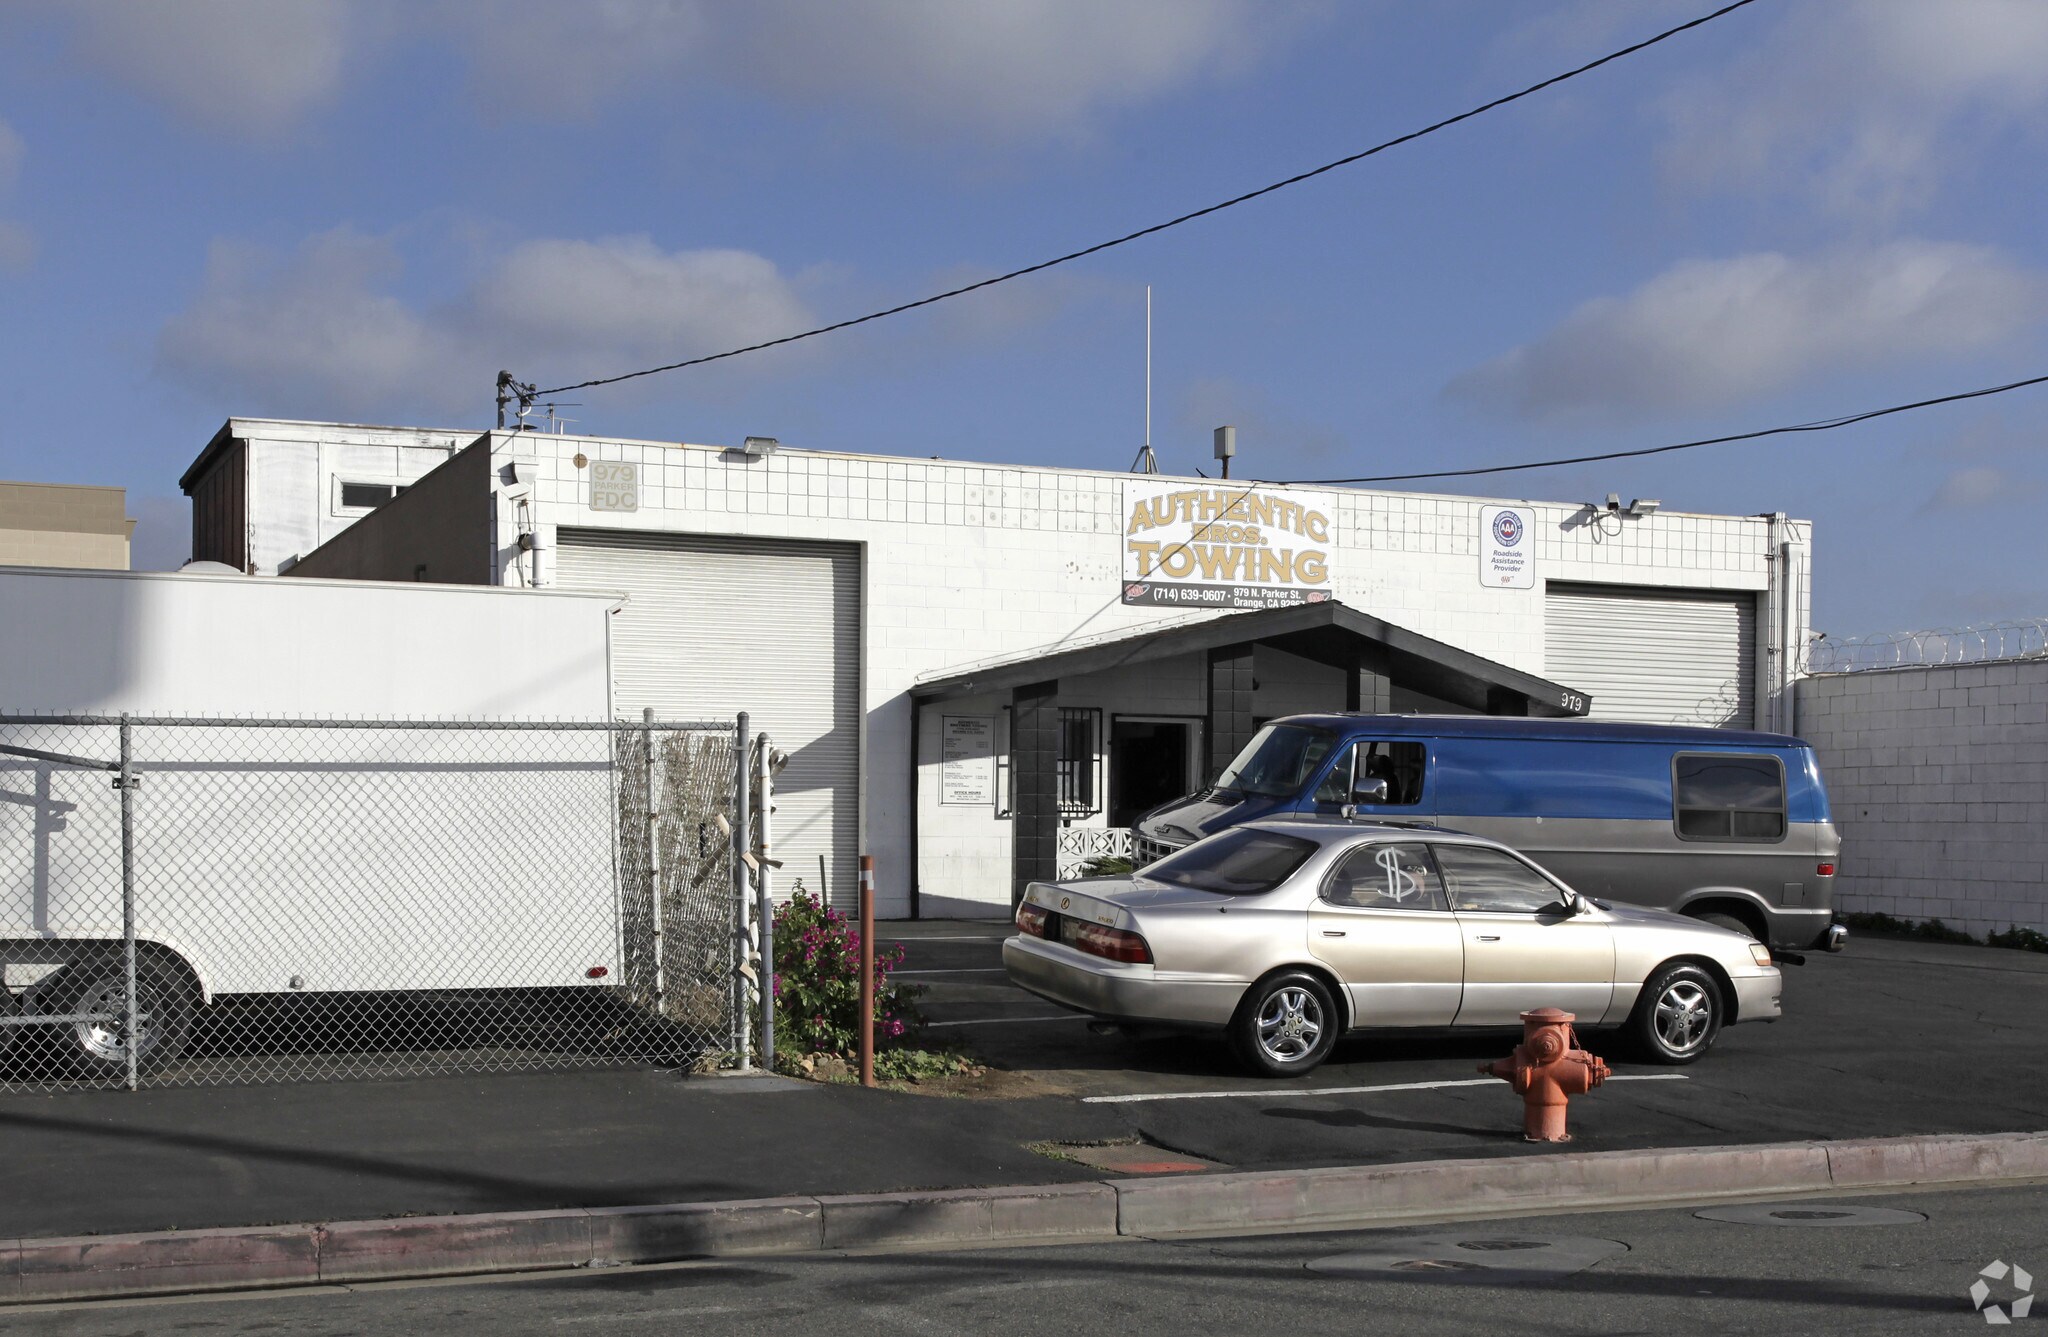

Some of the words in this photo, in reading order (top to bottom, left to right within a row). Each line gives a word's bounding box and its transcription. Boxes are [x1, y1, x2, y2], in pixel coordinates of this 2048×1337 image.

[594, 464, 634, 481] 979
[594, 482, 634, 491] PARKER
[593, 491, 635, 508] FDC
[1126, 489, 1330, 544] AUTHENTIC
[1191, 522, 1269, 545] BROS.
[1500, 522, 1515, 533] AAA
[1492, 549, 1523, 557] Roadside
[1126, 538, 1330, 584] TOWING
[1491, 557, 1525, 565] Assistance
[1493, 564, 1522, 572] Provider
[1154, 587, 1178, 601] (714)
[1181, 588, 1226, 601] 639-0607
[1234, 587, 1249, 597] 979
[1251, 588, 1260, 598] N.
[1261, 588, 1288, 599] Parker
[1290, 589, 1301, 599] St.
[1234, 597, 1266, 608] Orange,
[1267, 599, 1280, 608] CA
[1561, 692, 1582, 711] 979
